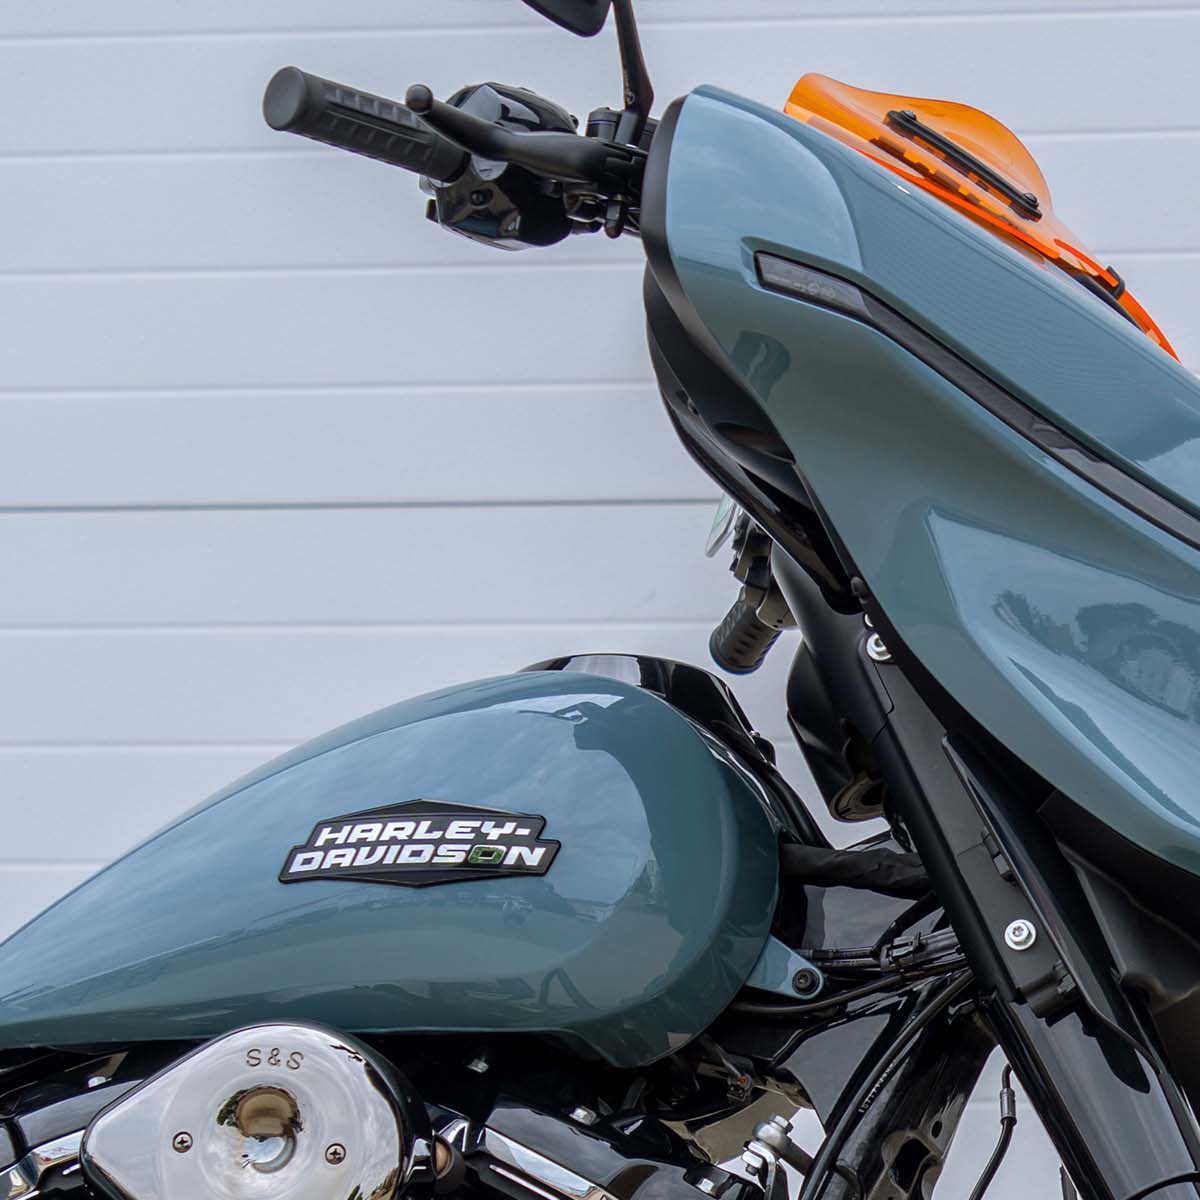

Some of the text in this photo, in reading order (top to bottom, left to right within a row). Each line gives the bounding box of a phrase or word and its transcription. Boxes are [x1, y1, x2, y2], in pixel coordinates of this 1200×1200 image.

[314, 820, 531, 847] HARLEY-
[288, 844, 546, 873] DAVIDSON
[246, 1047, 304, 1069] S&S
